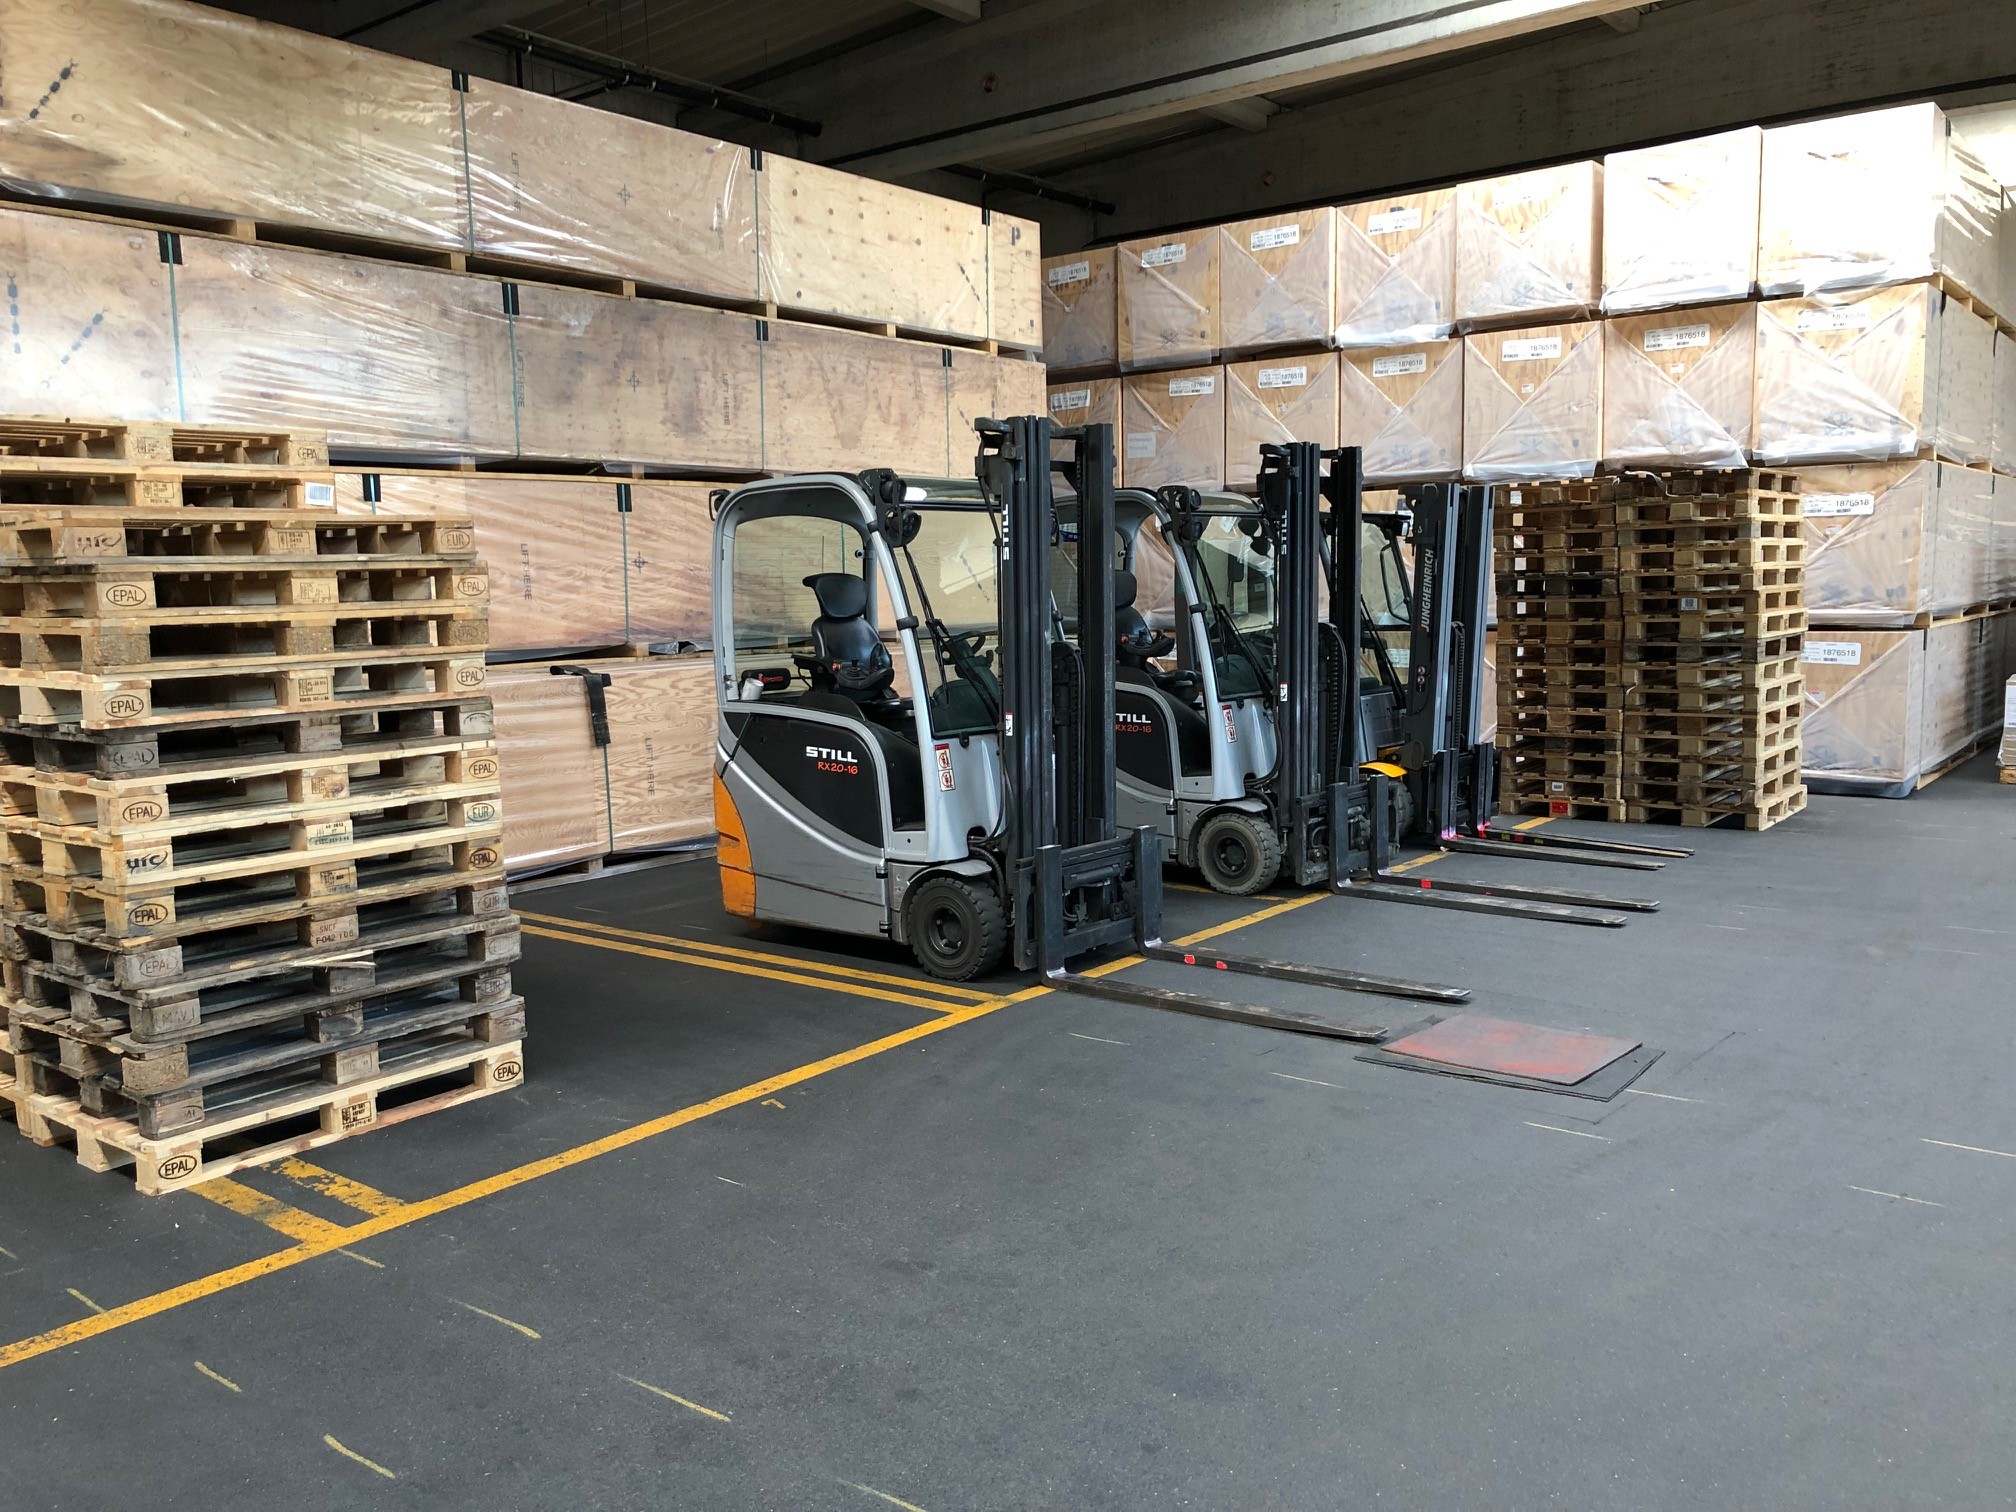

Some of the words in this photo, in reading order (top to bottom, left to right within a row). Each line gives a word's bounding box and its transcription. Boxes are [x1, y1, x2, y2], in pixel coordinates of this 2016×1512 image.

[1675, 331, 1706, 341] 1876518
[1836, 499, 1870, 508] 1876518
[1002, 503, 1010, 560] STILL
[446, 533, 465, 547] EUR
[520, 543, 530, 566] LIFT
[461, 580, 482, 593] EPAL
[523, 569, 533, 601] HERE
[1421, 548, 1434, 633] JUNGHEINRICH
[112, 589, 141, 602] EPAL
[1822, 648, 1856, 657] 1876518
[460, 670, 481, 683] EPAL
[110, 699, 139, 714] EPAL
[1115, 713, 1152, 724] TILL
[645, 737, 654, 761] LIFT
[806, 745, 859, 763] STILL
[473, 763, 494, 775] EPAL
[817, 761, 859, 775] RX20-16
[646, 765, 656, 797] HERE
[128, 805, 157, 820] EPAL
[472, 805, 489, 819] EUR
[473, 852, 495, 864] EPAL
[134, 907, 162, 923] EPAL
[319, 922, 337, 934] SNCF
[145, 960, 172, 974] EPAL
[497, 1064, 518, 1079] EPAL
[164, 1158, 192, 1177] EPAL
